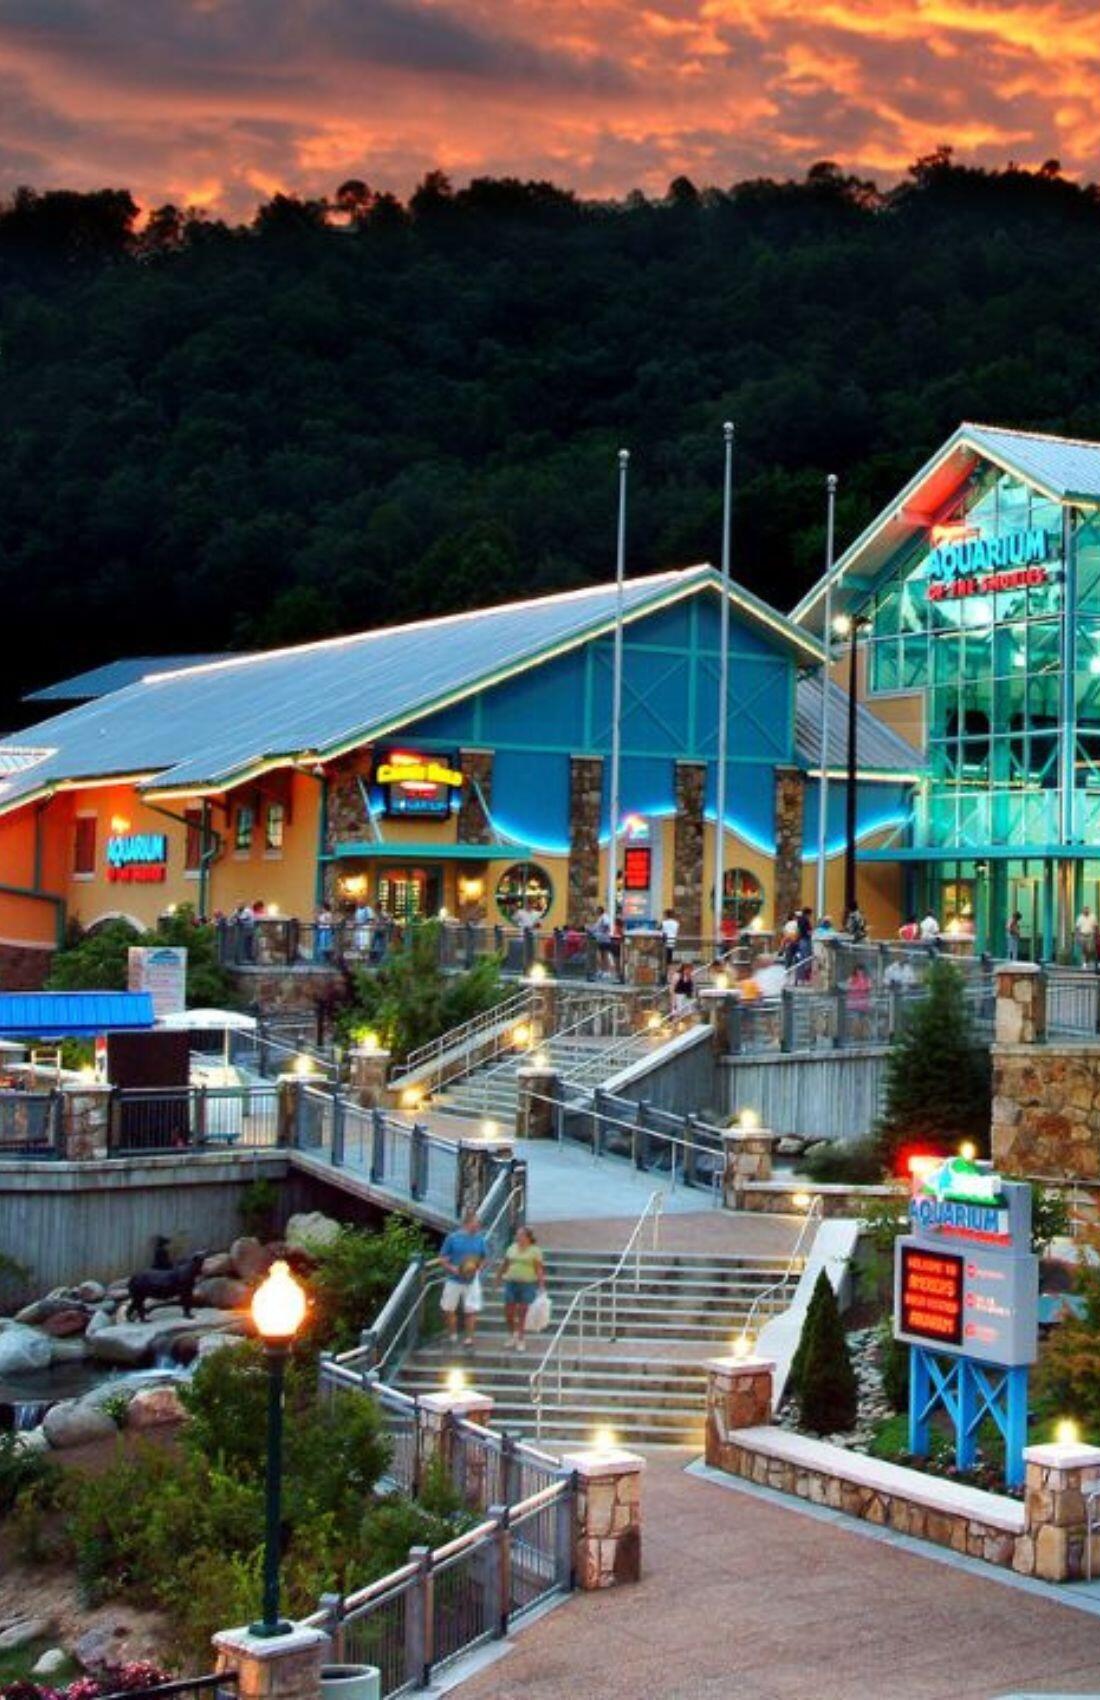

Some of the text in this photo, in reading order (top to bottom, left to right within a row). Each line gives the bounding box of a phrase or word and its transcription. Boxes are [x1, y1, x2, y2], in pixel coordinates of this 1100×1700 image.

[924, 529, 1048, 581] AQUARIUM
[106, 834, 166, 868] AQUARIUM
[910, 1198, 1000, 1233] AQUARIUM
